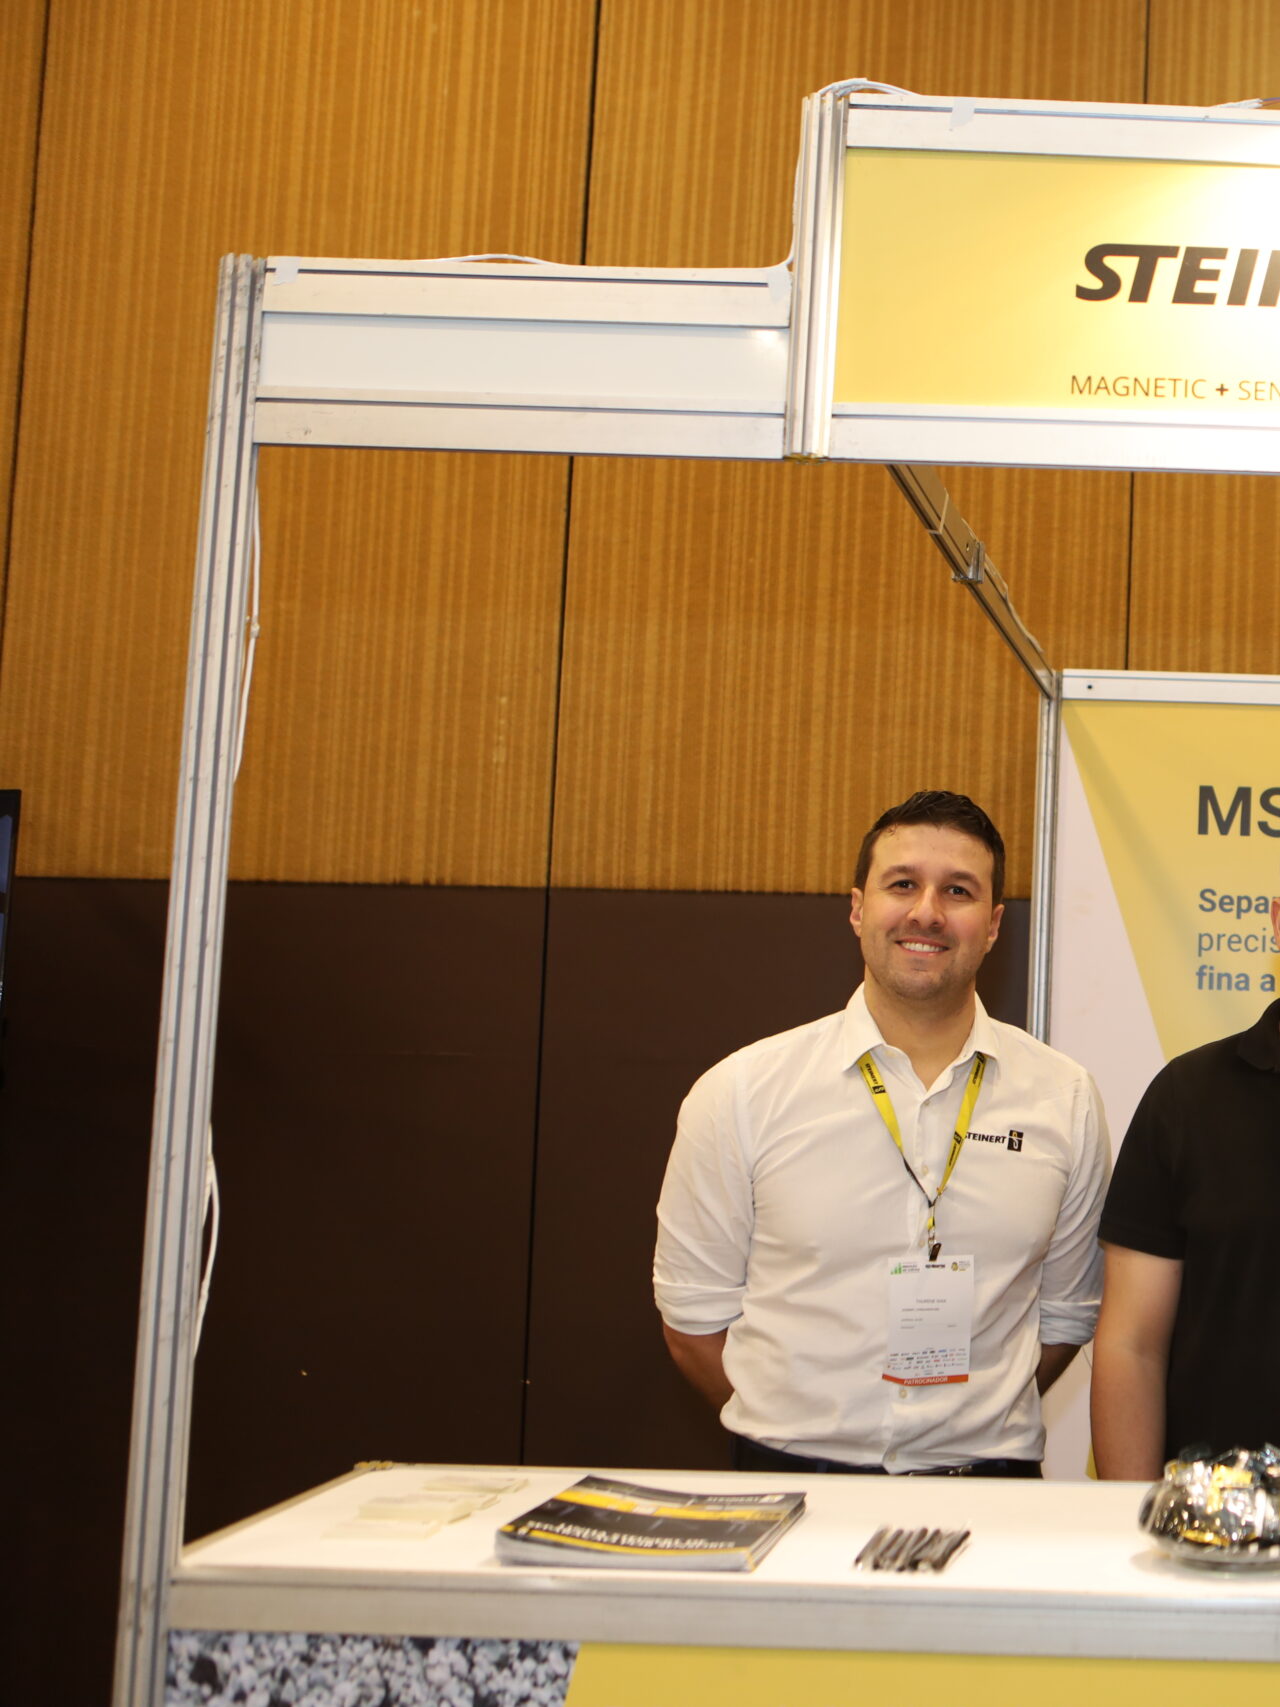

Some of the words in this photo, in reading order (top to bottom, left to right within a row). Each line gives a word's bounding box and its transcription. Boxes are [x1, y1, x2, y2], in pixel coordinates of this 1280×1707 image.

[1071, 375, 1207, 399] MAGNETIC
[1198, 888, 1270, 920] Sepa
[1195, 964, 1250, 991] fina
[1260, 973, 1276, 992] a
